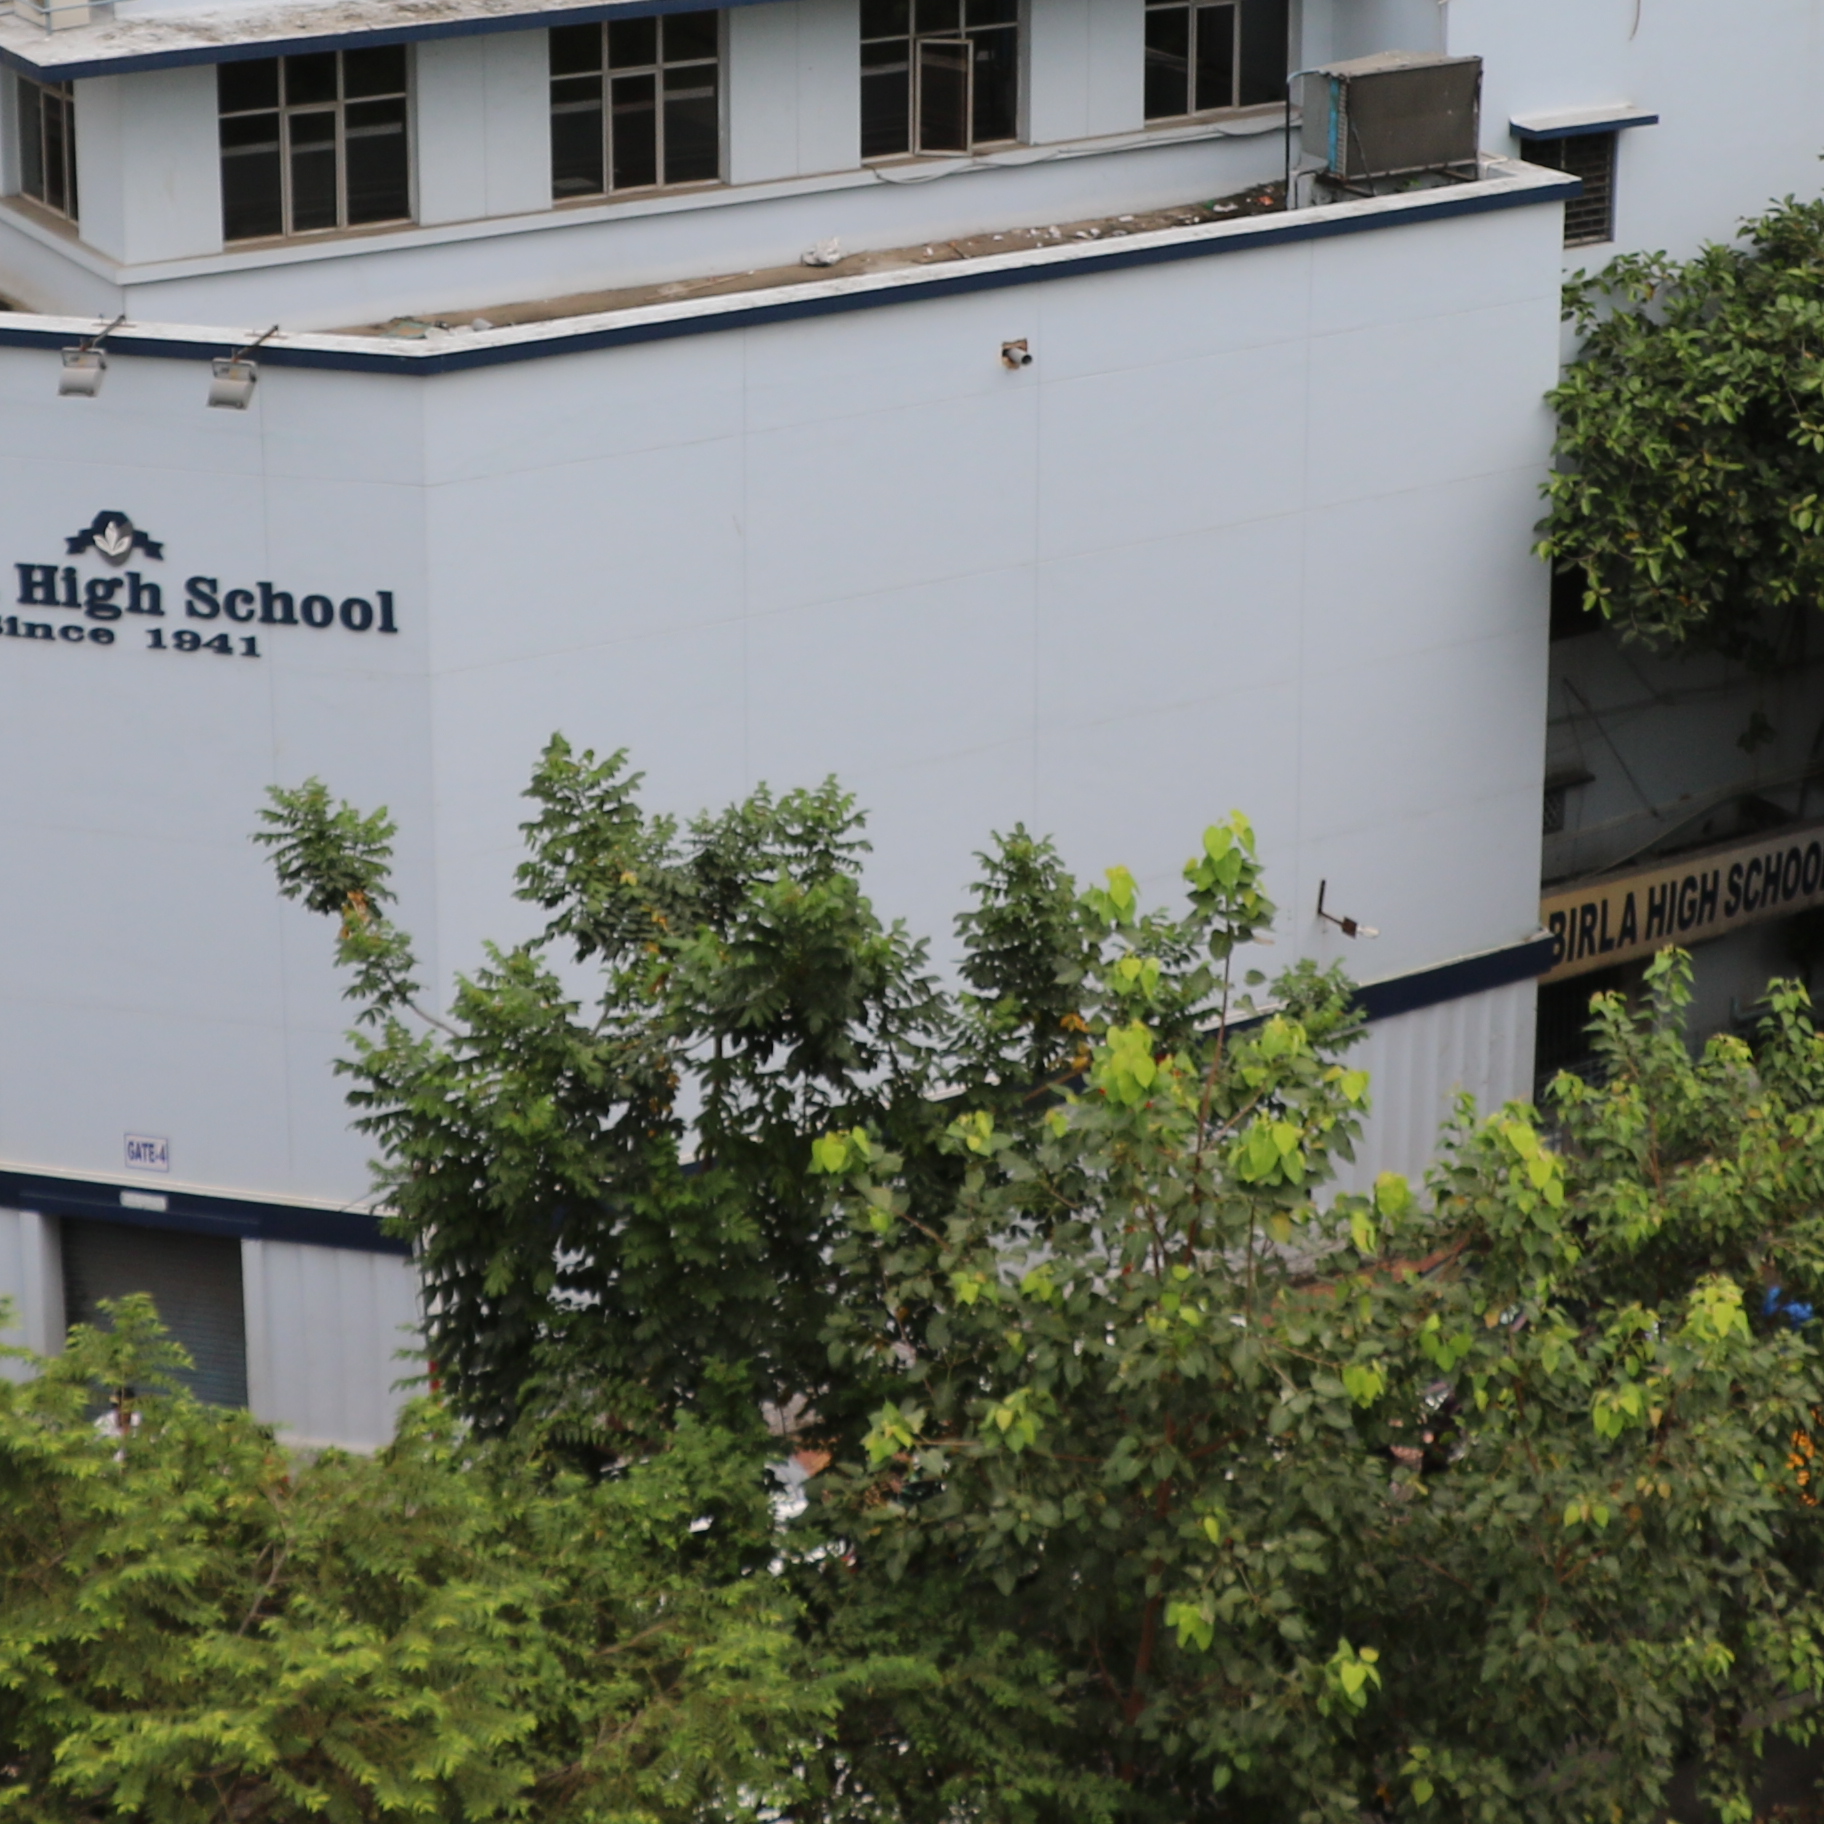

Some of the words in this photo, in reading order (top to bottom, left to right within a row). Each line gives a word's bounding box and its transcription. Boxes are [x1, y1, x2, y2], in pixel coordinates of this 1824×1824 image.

[15, 563, 166, 622] High
[184, 576, 399, 634] School
[146, 628, 262, 658] 1941
[1549, 891, 1638, 965] BIRLA
[1645, 870, 1720, 941] HIGH
